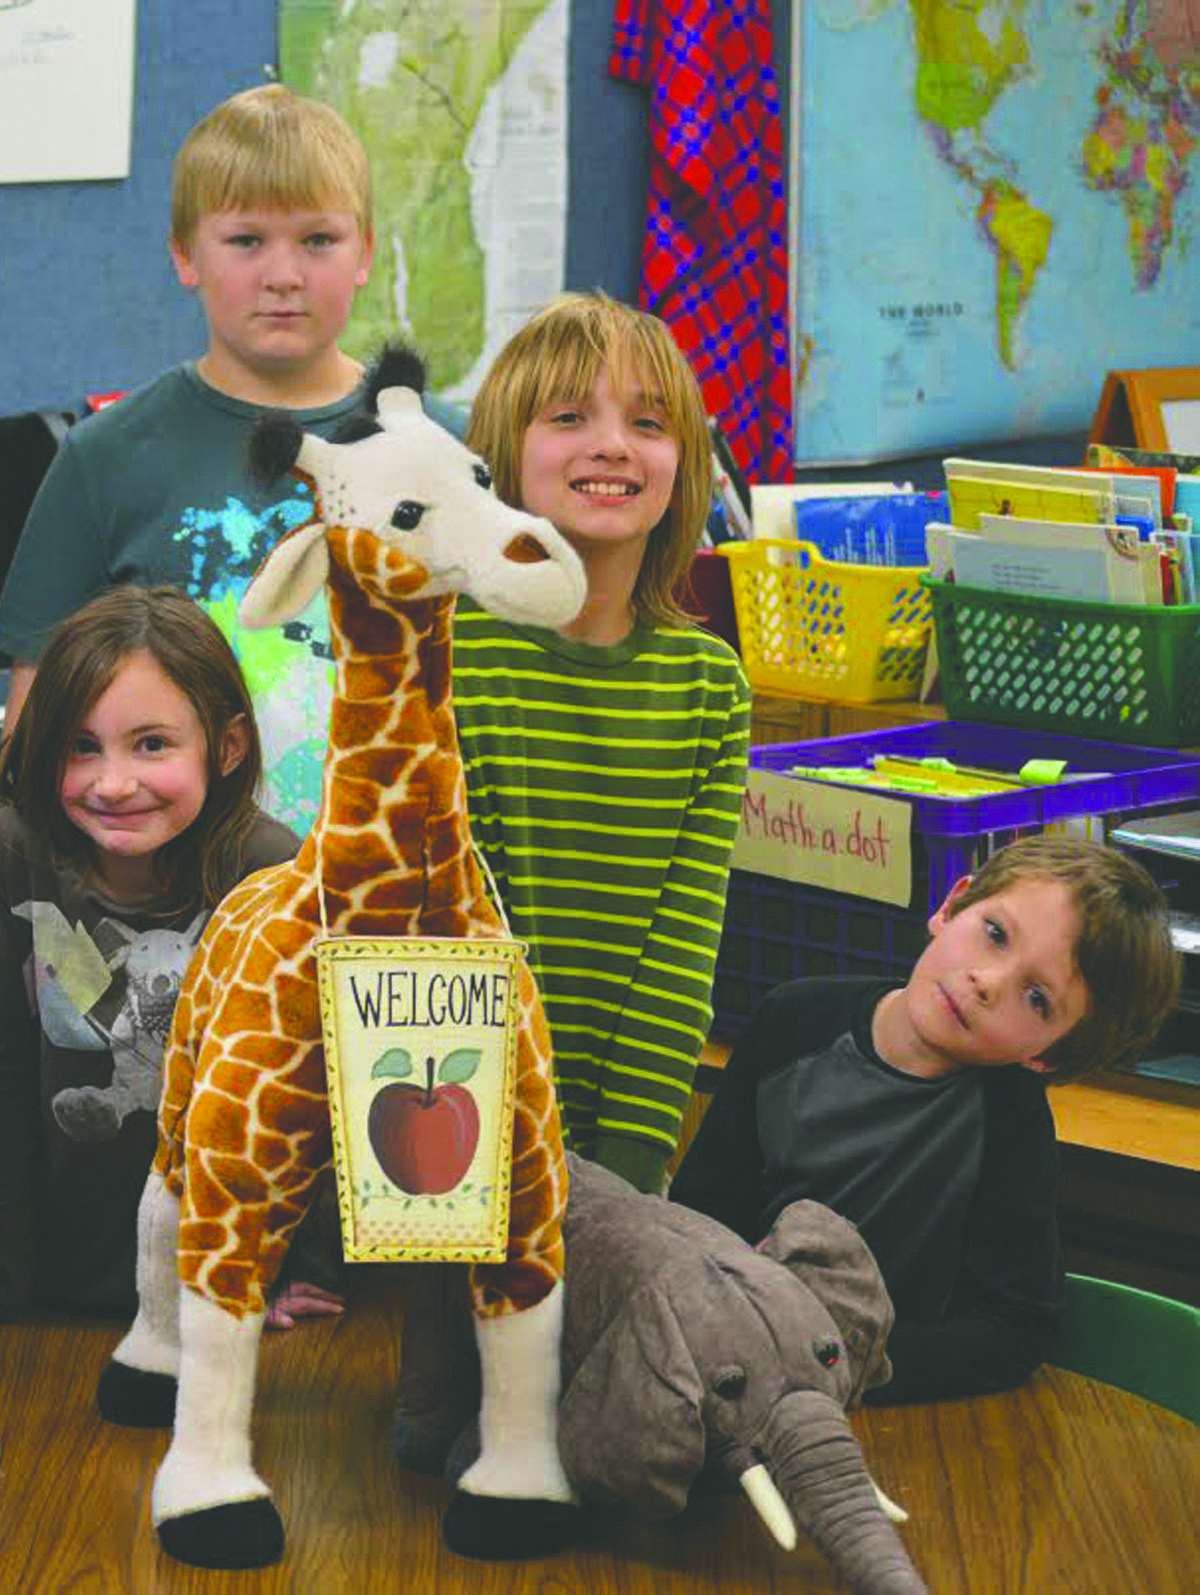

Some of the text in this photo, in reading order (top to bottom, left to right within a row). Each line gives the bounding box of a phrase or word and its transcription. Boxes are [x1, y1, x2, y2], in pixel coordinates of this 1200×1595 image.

[911, 301, 964, 318] WORLD
[846, 807, 892, 868] dot
[349, 970, 509, 1028] WELCOME
